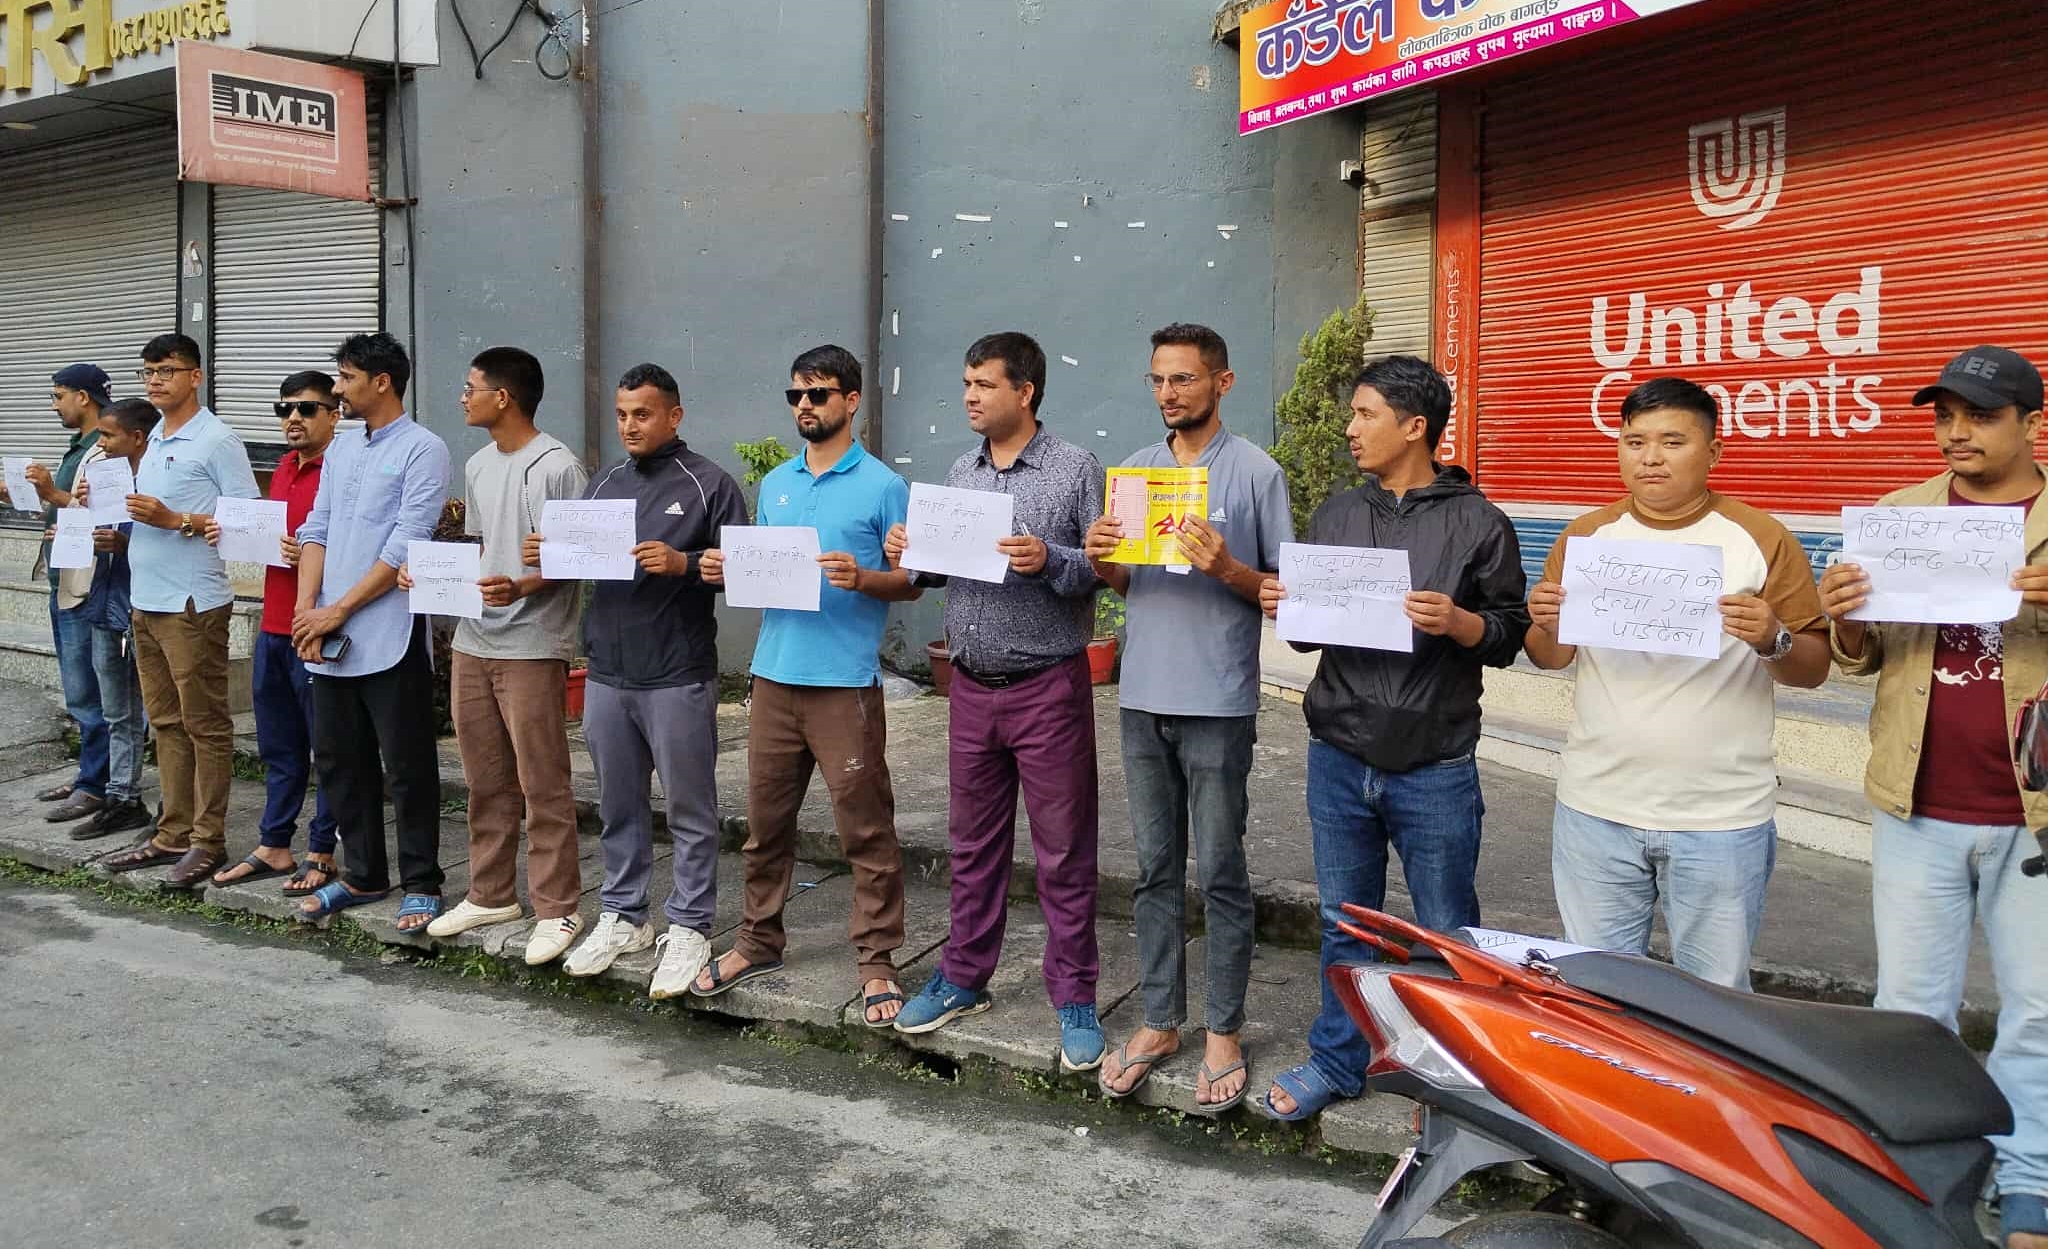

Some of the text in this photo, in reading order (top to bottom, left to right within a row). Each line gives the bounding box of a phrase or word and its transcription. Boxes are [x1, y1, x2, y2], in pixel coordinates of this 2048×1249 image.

[1479, 12, 1505, 32] चोक
[1391, 61, 1417, 81] लागि
[233, 87, 326, 131] IME
[1590, 266, 1883, 370] United
[1590, 362, 1883, 440] Cents
